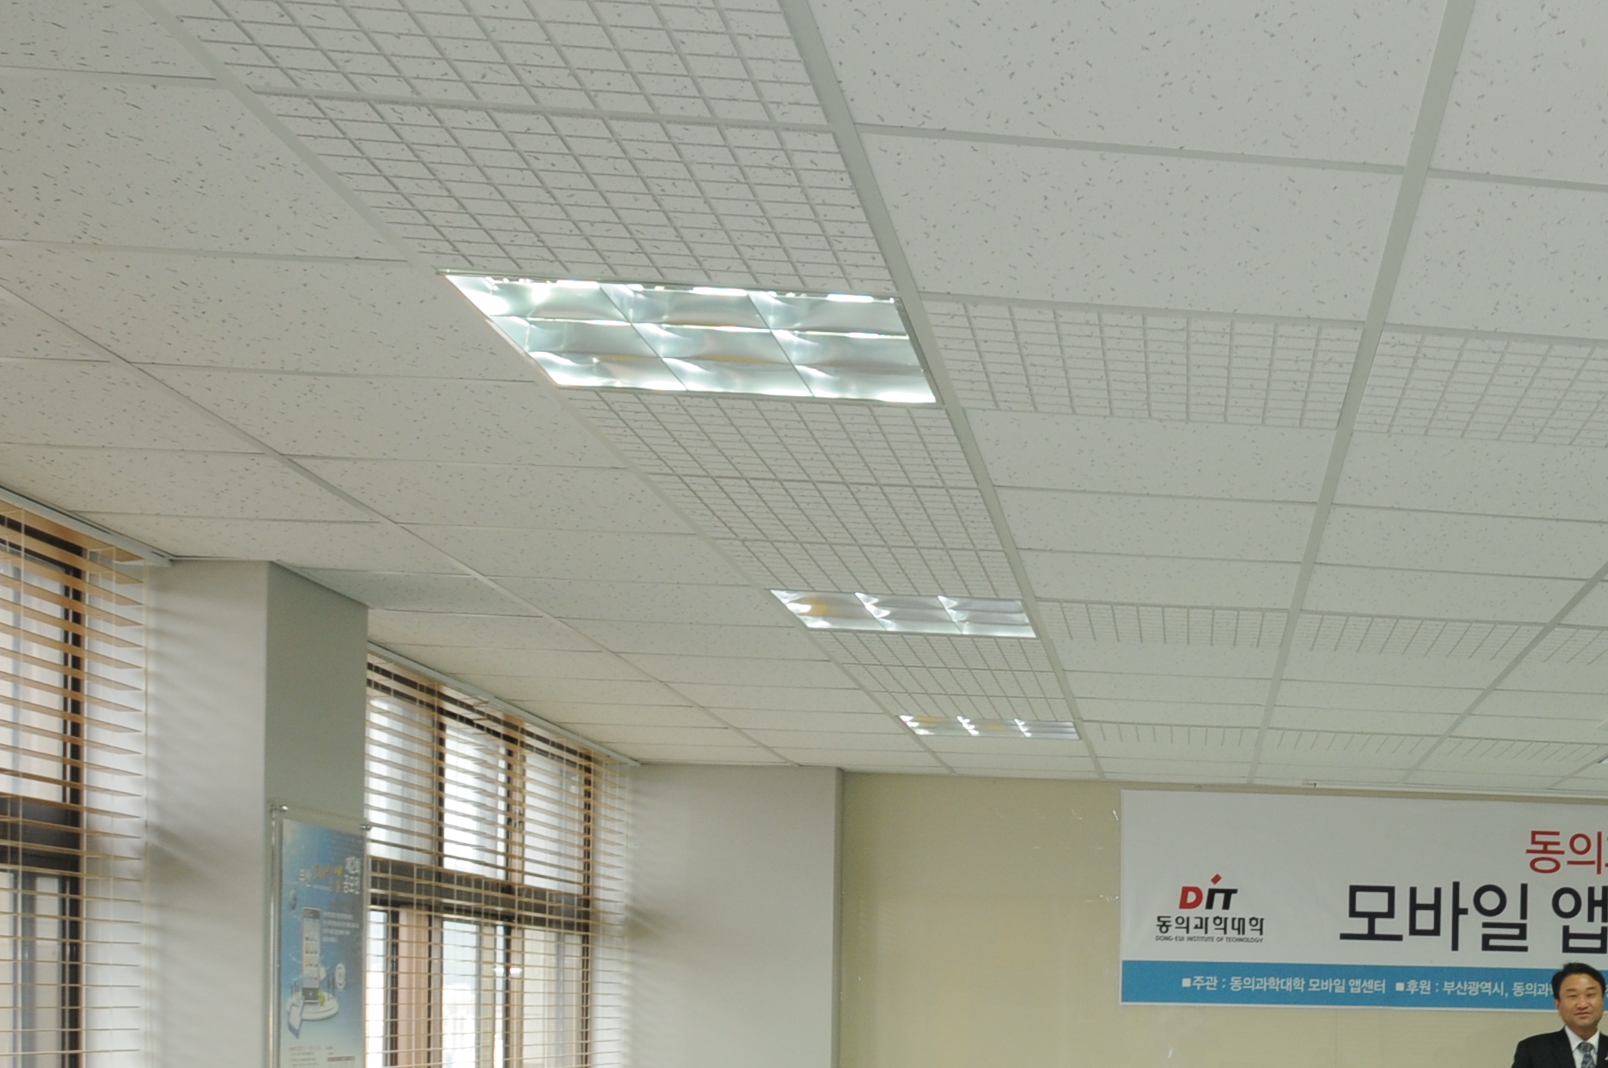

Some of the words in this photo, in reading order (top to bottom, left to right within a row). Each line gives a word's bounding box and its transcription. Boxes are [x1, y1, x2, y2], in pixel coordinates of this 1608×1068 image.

[1179, 873, 1238, 911] DIT
[1156, 915, 1265, 936] 동의과학대학
[1339, 882, 1531, 952] 모바일
[1192, 975, 1218, 990] 주관
[1230, 976, 1305, 992] 동의과학대학
[1308, 978, 1345, 993] 모바일
[1348, 978, 1386, 994] 앱센터
[1406, 980, 1431, 995] 후원
[1443, 980, 1508, 998] 부산광역시,
[1512, 981, 1554, 997] 동의과
